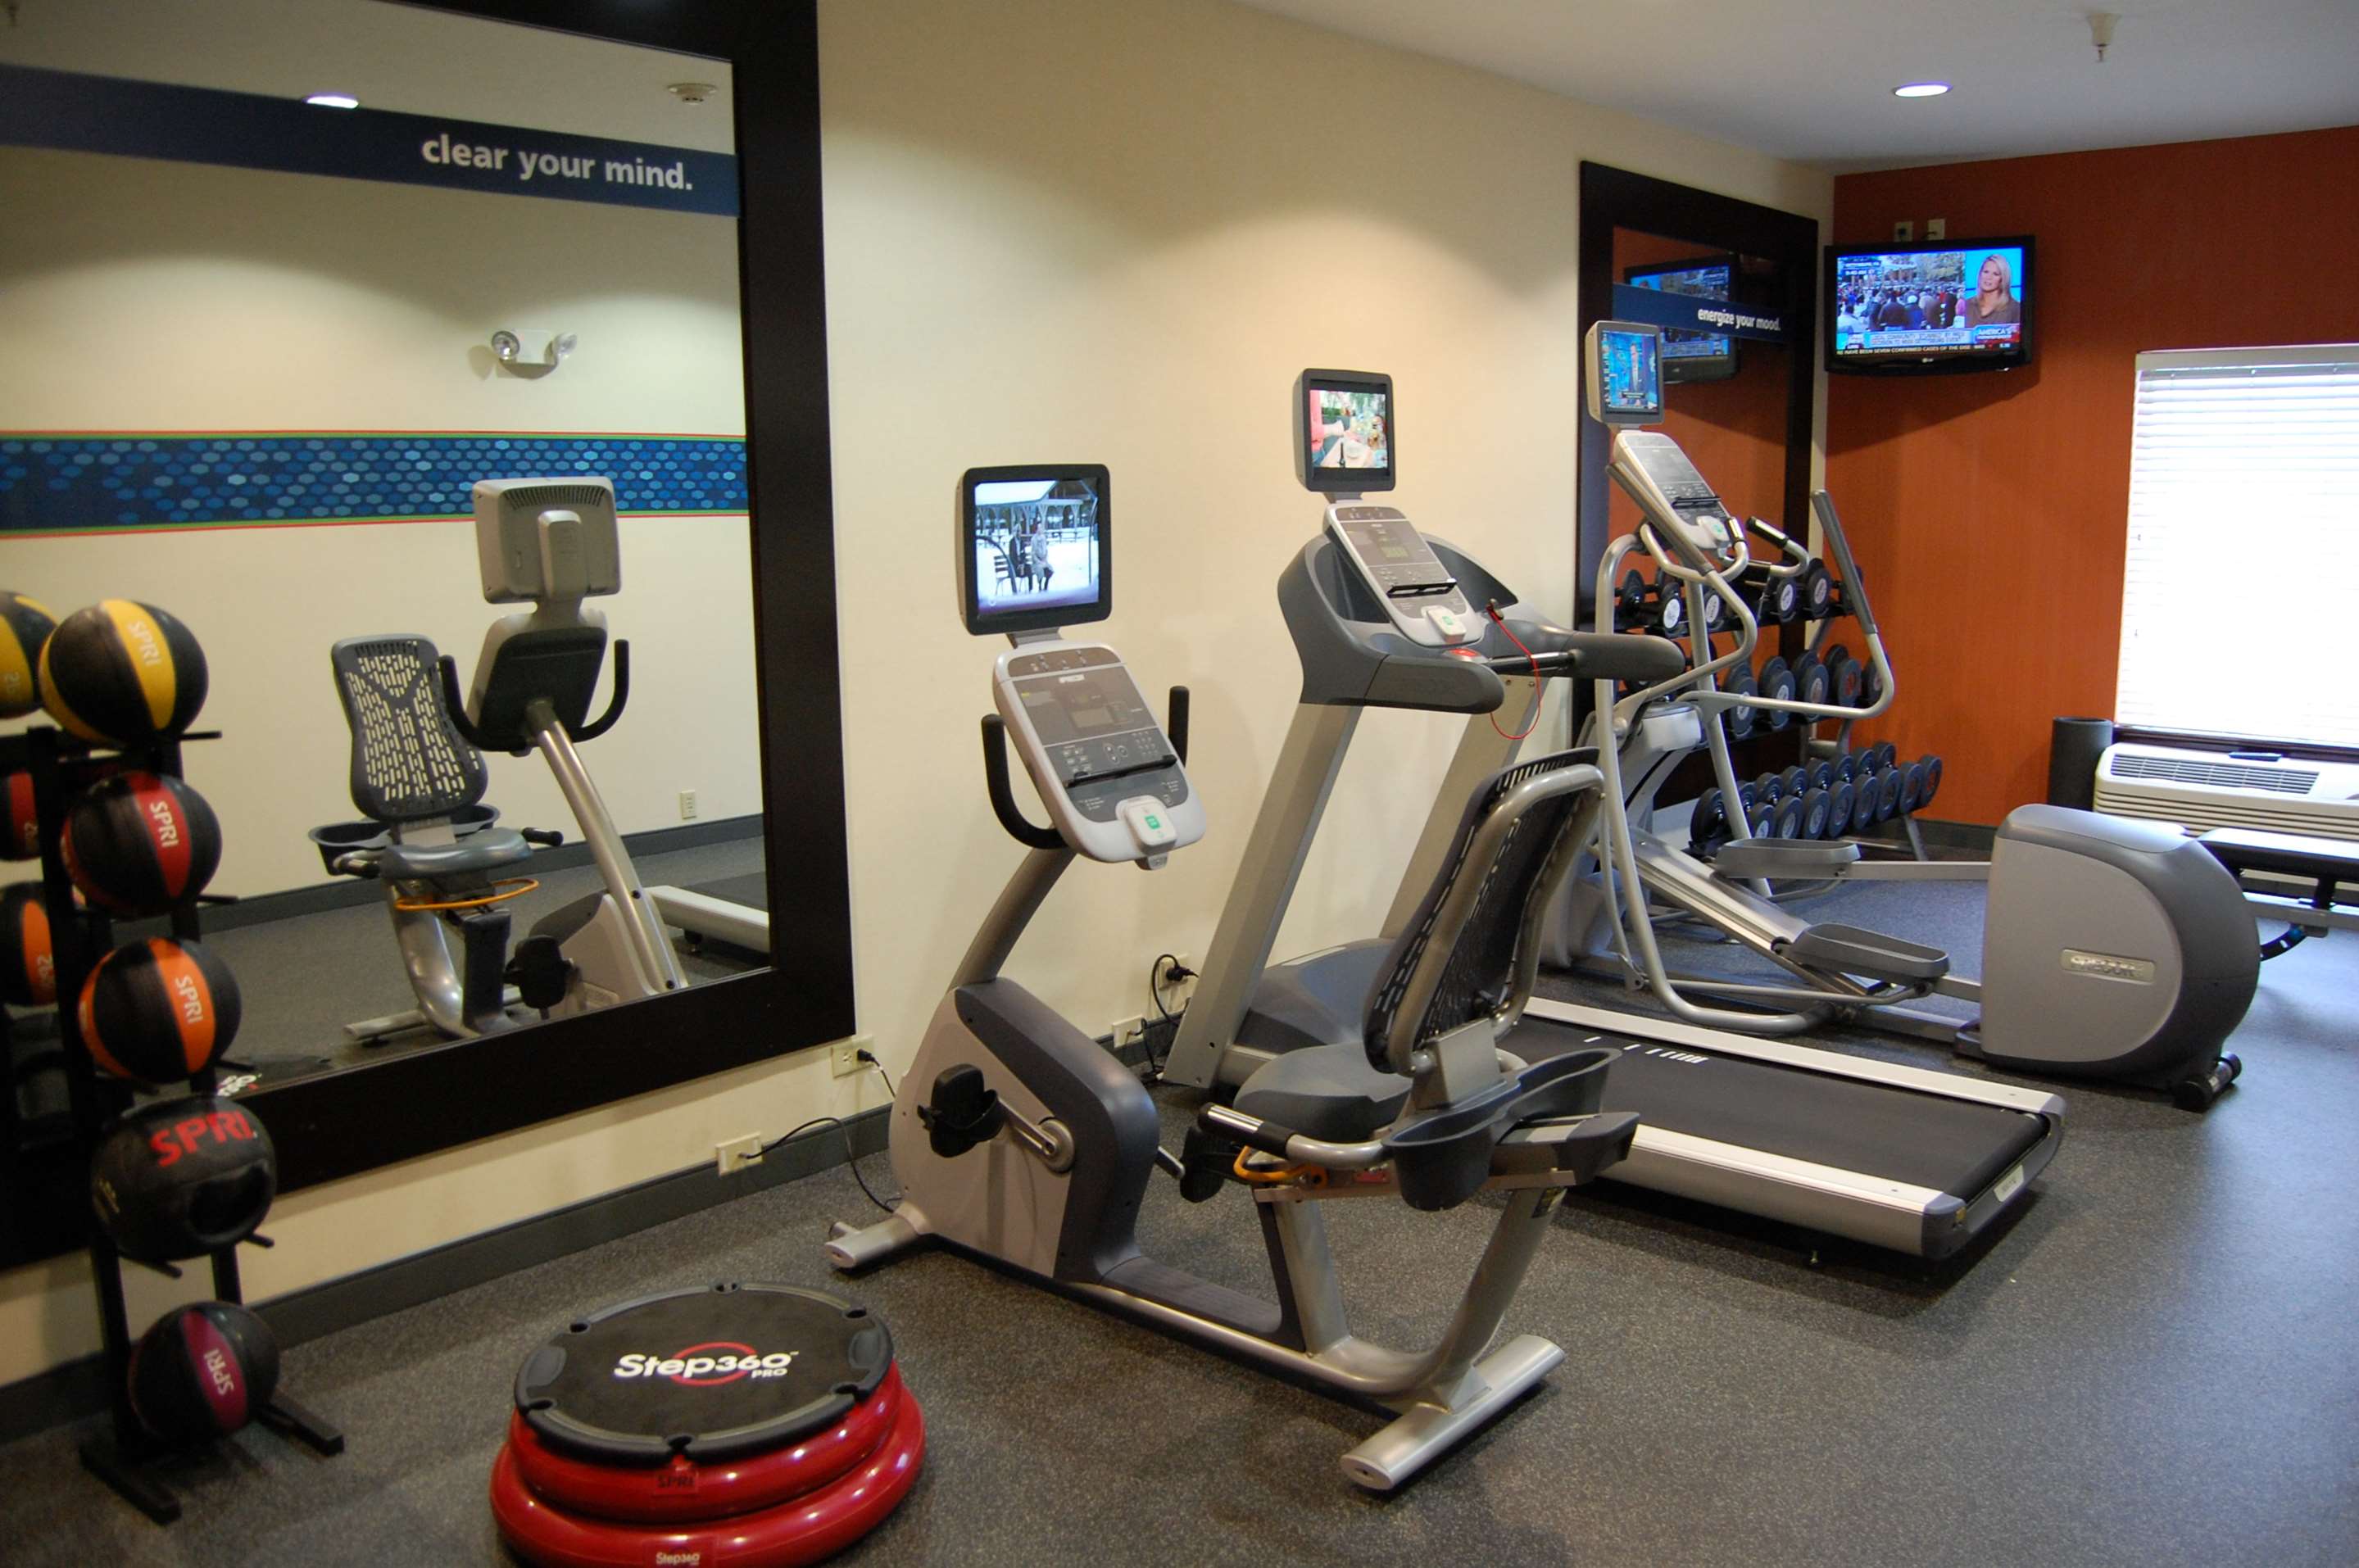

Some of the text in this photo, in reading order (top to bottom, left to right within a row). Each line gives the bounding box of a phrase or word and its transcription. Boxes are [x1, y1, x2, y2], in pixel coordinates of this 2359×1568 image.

[421, 134, 693, 190] clear your mind.
[1698, 309, 1781, 330] energize your mood.
[128, 620, 160, 665] SPRI
[150, 800, 178, 847] SPRI
[175, 975, 205, 1025] SPRI
[150, 1111, 254, 1167] SPRI
[202, 1348, 235, 1397] SPRI
[751, 1367, 788, 1379] PRO
